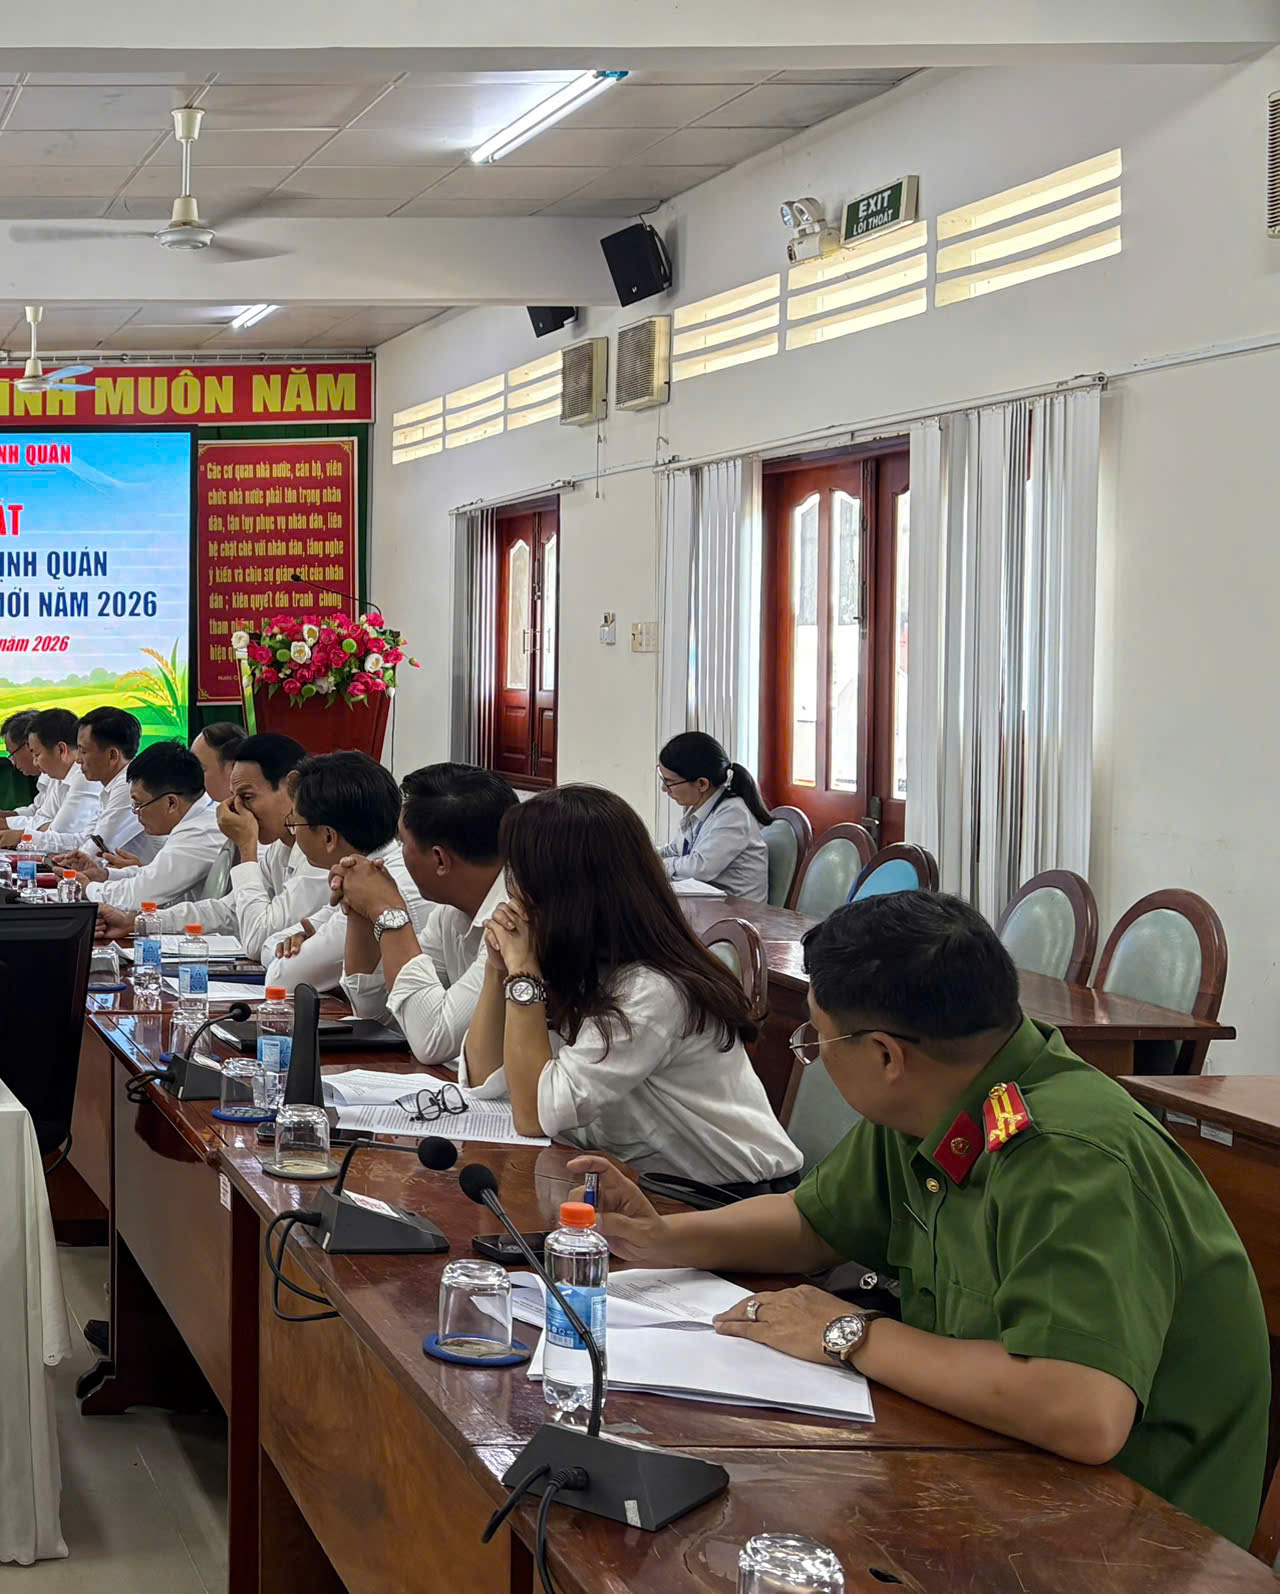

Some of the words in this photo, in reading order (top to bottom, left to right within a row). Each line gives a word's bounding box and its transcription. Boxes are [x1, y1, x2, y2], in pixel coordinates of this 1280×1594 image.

[859, 190, 891, 218] EXIT
[868, 208, 893, 230] THOÁT
[95, 370, 235, 416] MUÔN
[252, 368, 357, 412] NĂM
[25, 442, 71, 465] QUÁN
[46, 546, 108, 580] QUÁN
[39, 587, 89, 617] NĂM
[97, 591, 157, 617] 2026
[32, 636, 70, 652] 2026
